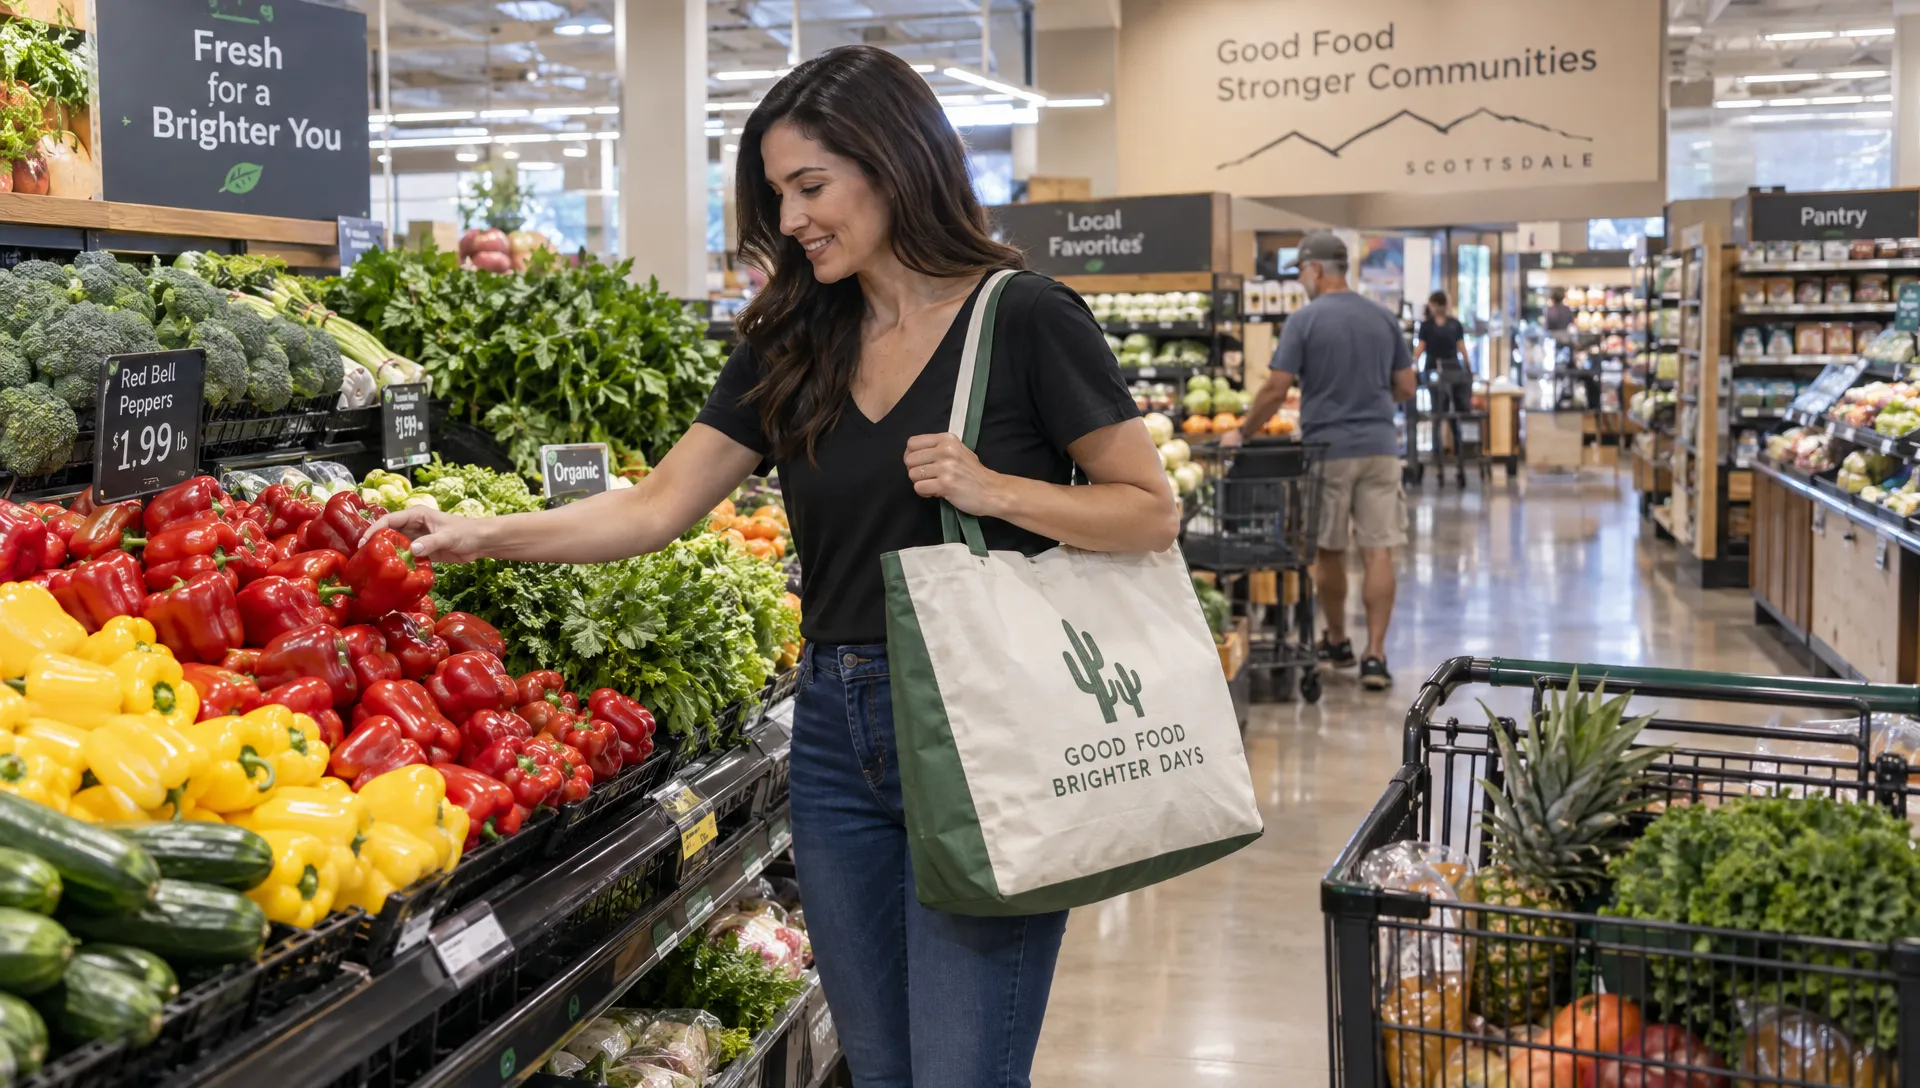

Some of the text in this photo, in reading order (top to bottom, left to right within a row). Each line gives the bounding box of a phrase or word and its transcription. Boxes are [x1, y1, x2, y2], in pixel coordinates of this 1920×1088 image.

[194, 29, 283, 69] Fresh
[1216, 22, 1395, 65] Good Food
[207, 71, 271, 106] for a
[1216, 45, 1598, 102] Stronger Communities
[152, 106, 342, 151] Brighter You
[1405, 152, 1594, 176] SCOTTSDALE
[1067, 208, 1122, 232] Local
[1800, 206, 1868, 229] Pantry
[1048, 235, 1143, 257] Favorites
[121, 362, 176, 388] Red Bell
[119, 394, 173, 418] Peppers
[112, 422, 188, 471] $1.99 lb
[554, 460, 600, 486] Organic
[1064, 724, 1185, 766] GOOD FOOD
[1052, 746, 1204, 797] BRIGHTER DAYS
